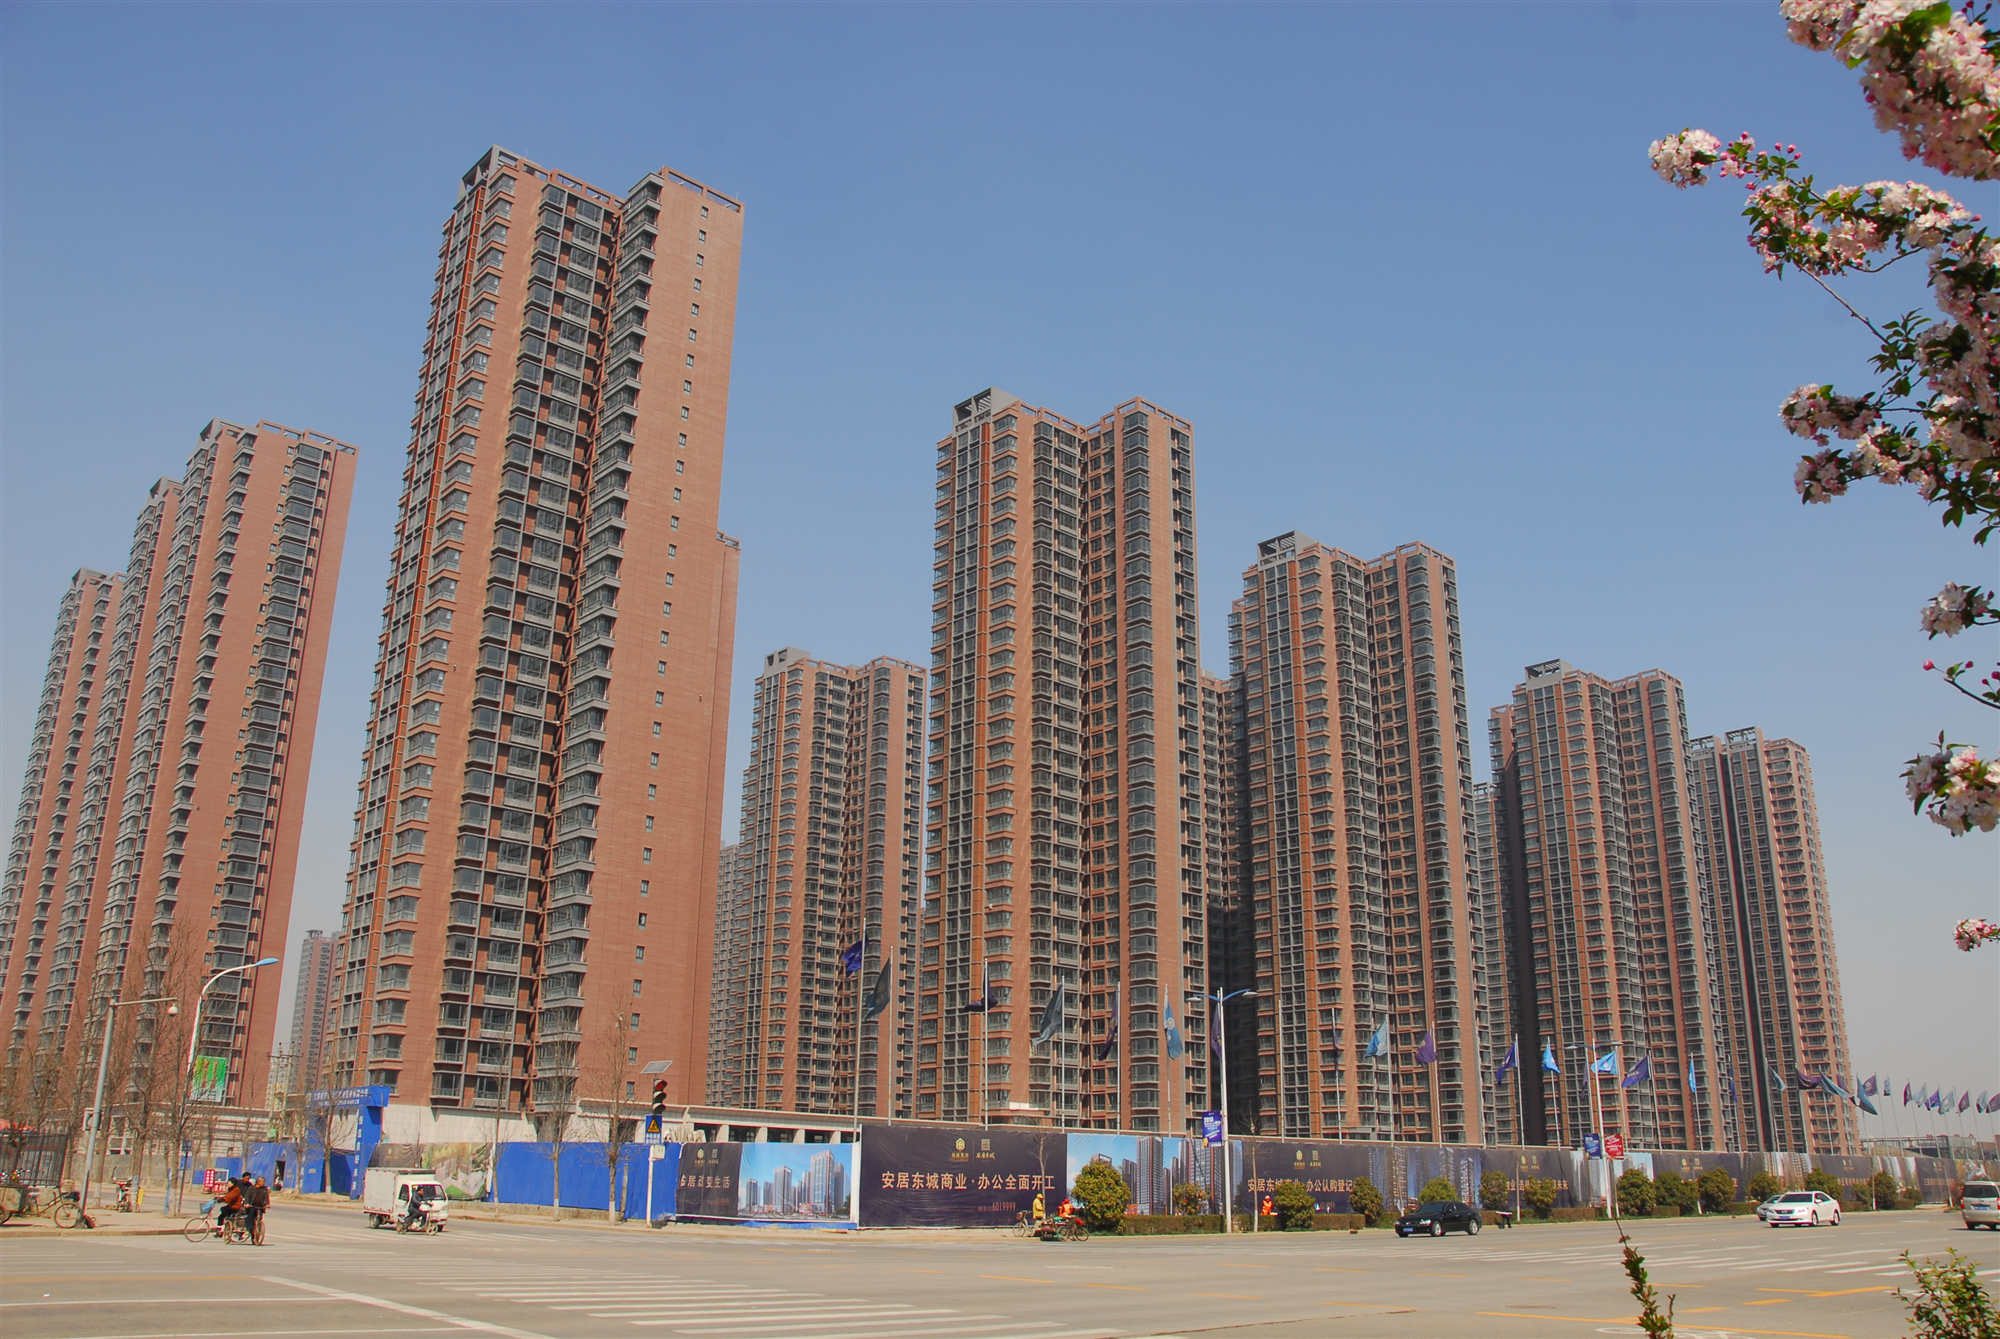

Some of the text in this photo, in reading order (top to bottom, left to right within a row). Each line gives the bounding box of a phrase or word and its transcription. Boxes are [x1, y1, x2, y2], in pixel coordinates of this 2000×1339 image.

[881, 1171, 1056, 1191] 安居东城商业·办公全面开工
